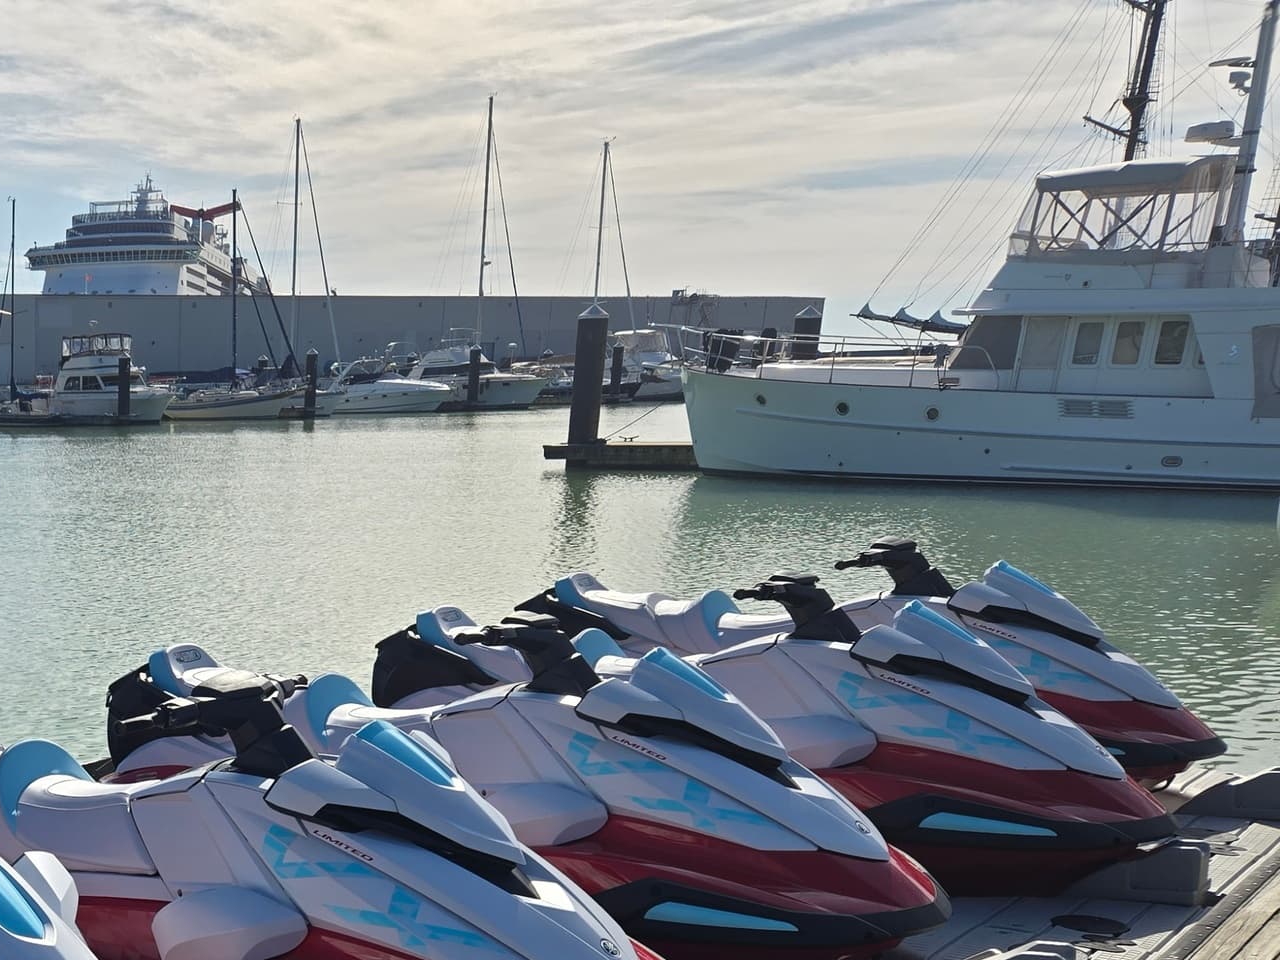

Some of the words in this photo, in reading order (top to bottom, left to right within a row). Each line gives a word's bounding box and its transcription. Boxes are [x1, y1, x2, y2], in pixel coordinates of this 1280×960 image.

[880, 673, 930, 695] LIMITED
[612, 735, 667, 761] LIMITED
[313, 829, 374, 862] LIMITED
